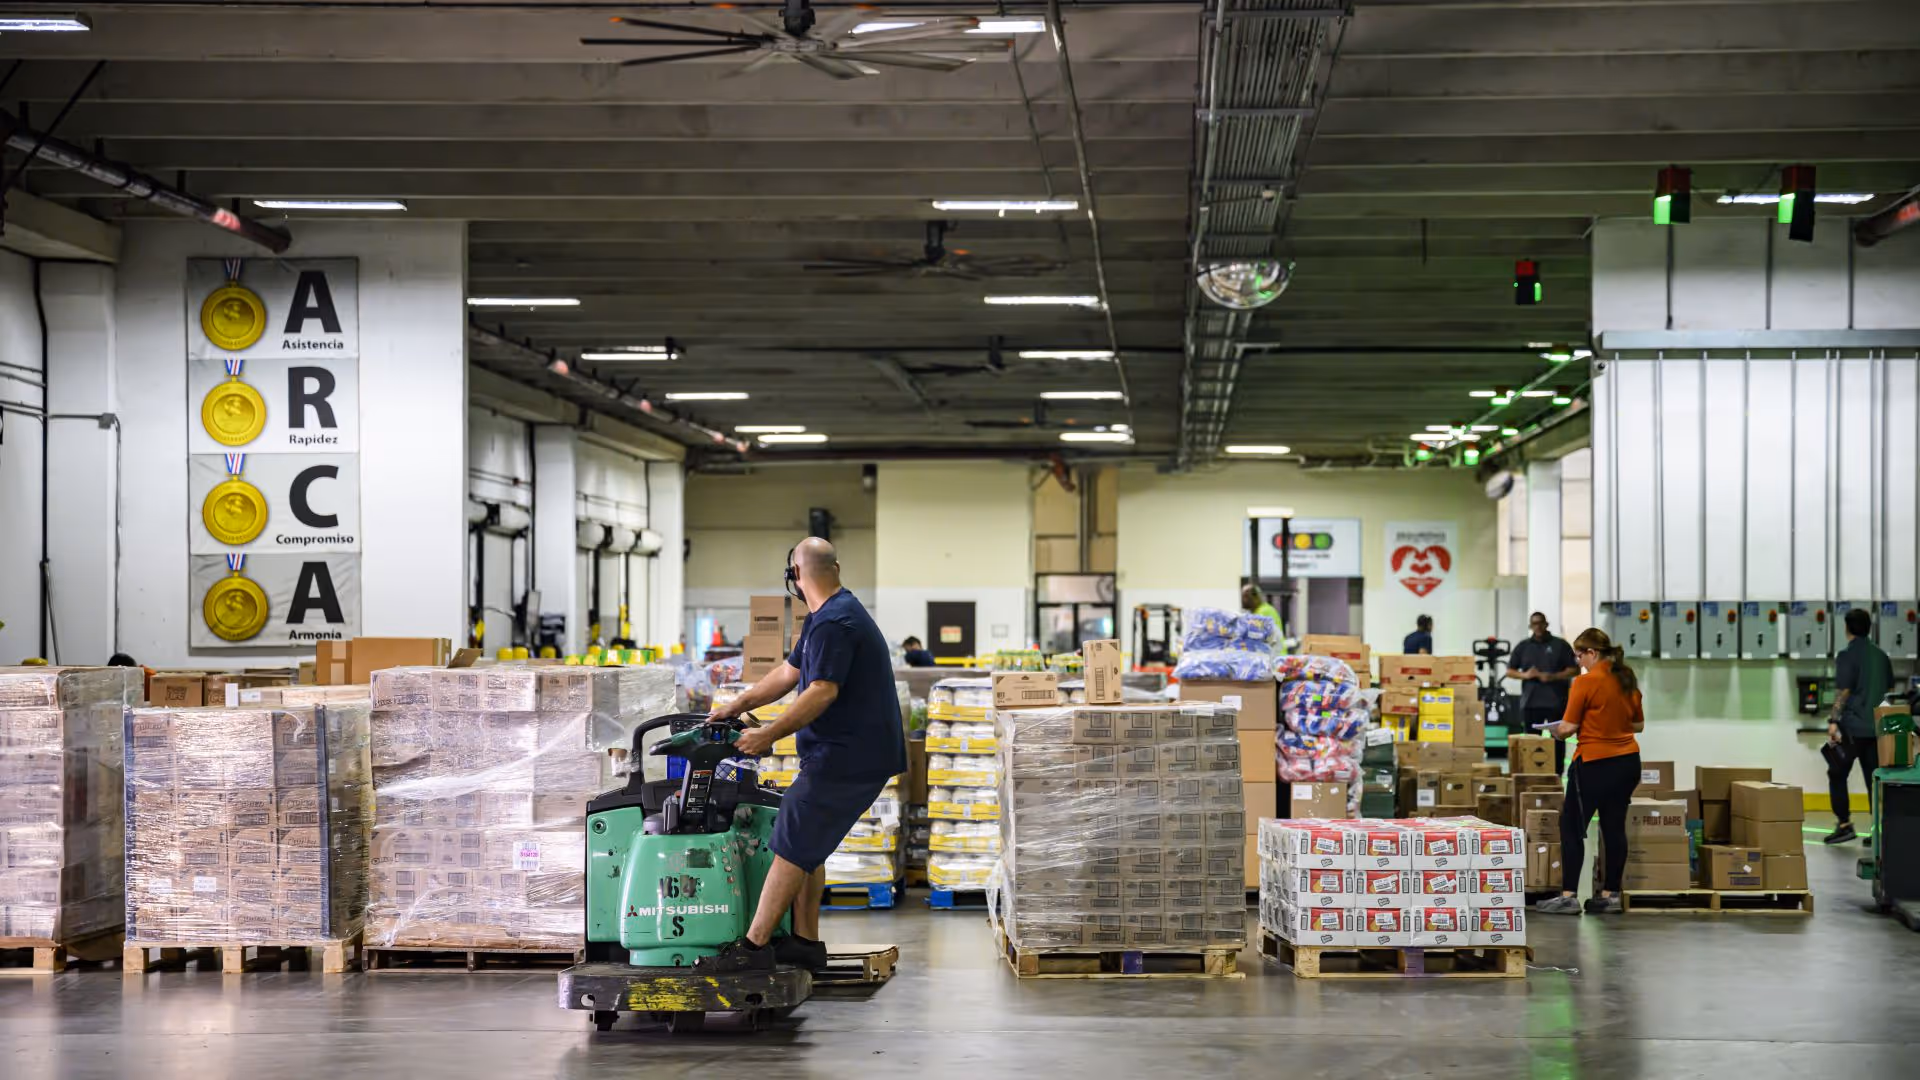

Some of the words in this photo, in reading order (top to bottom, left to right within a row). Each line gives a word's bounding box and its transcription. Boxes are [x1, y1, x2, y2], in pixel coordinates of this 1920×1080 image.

[284, 270, 342, 333] A
[282, 339, 344, 350] Asistencia
[288, 366, 338, 428] R
[289, 434, 338, 446] Rapidez
[289, 465, 339, 528] C
[276, 533, 354, 546] Compromiso
[286, 561, 345, 624] A
[1643, 815, 1661, 825] FRUIT
[1663, 815, 1681, 825] BARS
[639, 904, 729, 916] MITSUBISHI
[672, 915, 684, 937] S
